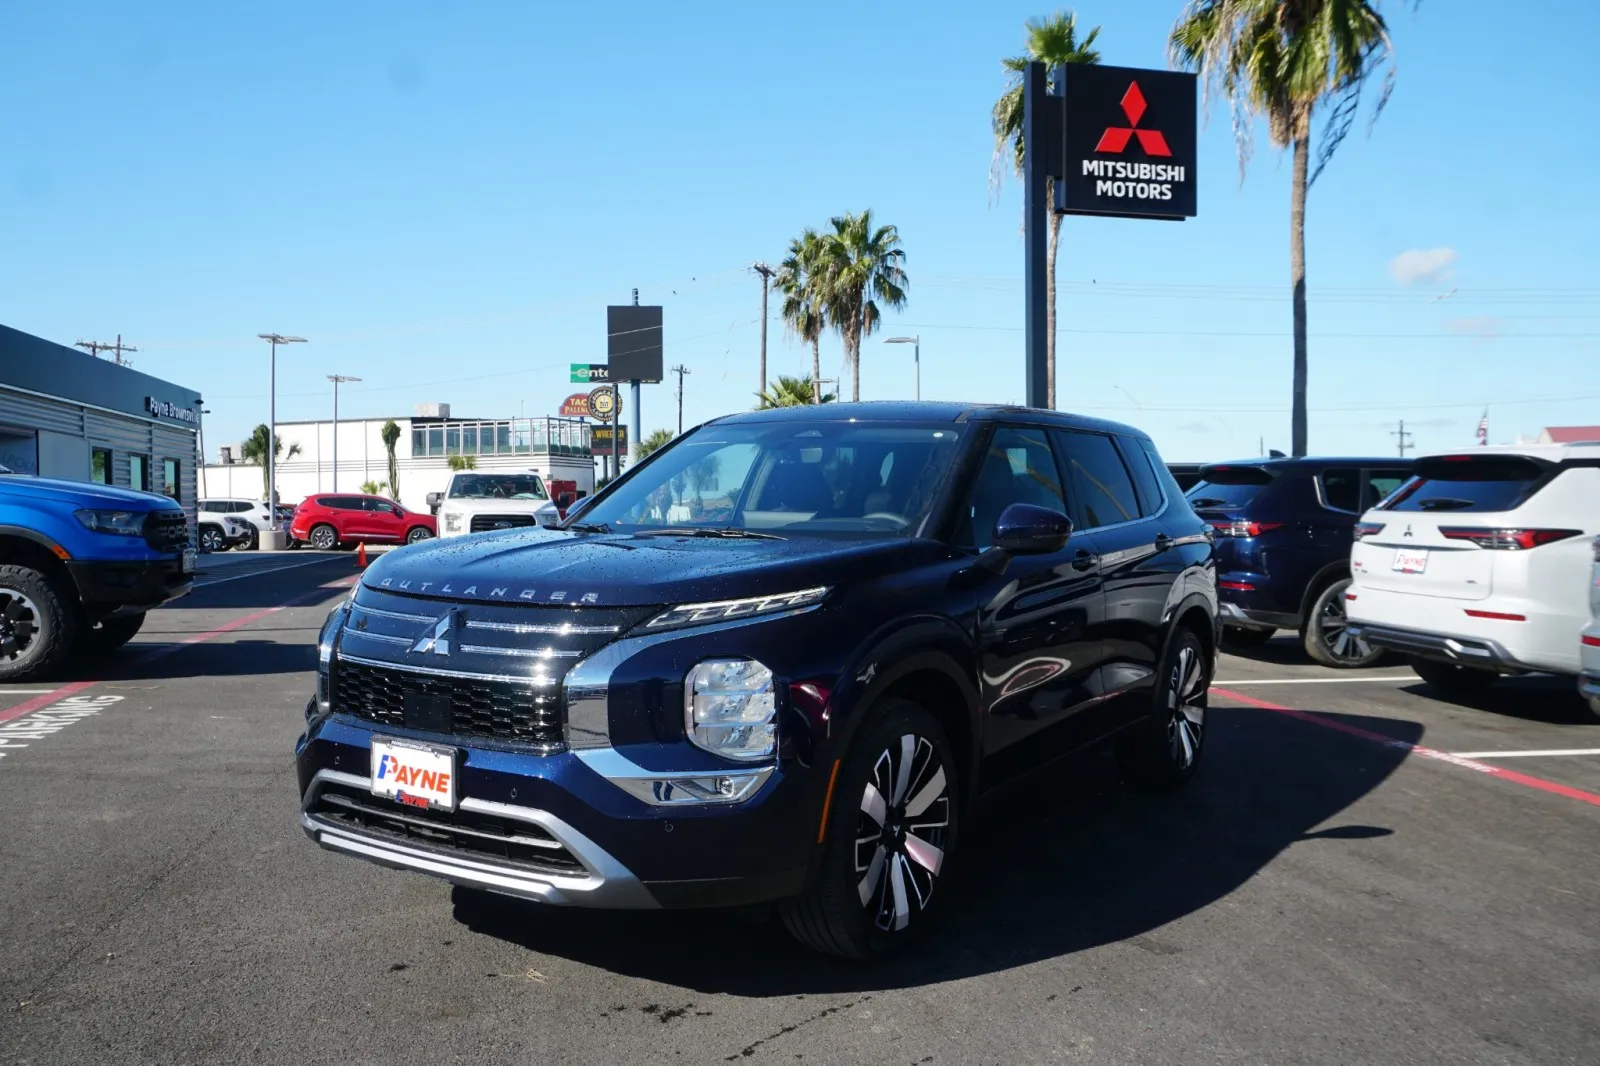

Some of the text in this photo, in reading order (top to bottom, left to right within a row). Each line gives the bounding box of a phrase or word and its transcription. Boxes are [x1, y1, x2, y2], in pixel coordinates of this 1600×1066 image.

[1082, 160, 1185, 182] MITSUBISHI
[1096, 180, 1172, 200] MOTORS
[150, 396, 199, 424] Payne Brownsville
[570, 398, 588, 407] TAC
[381, 577, 599, 603] OUTLANDER
[377, 754, 450, 793] PAYNE
